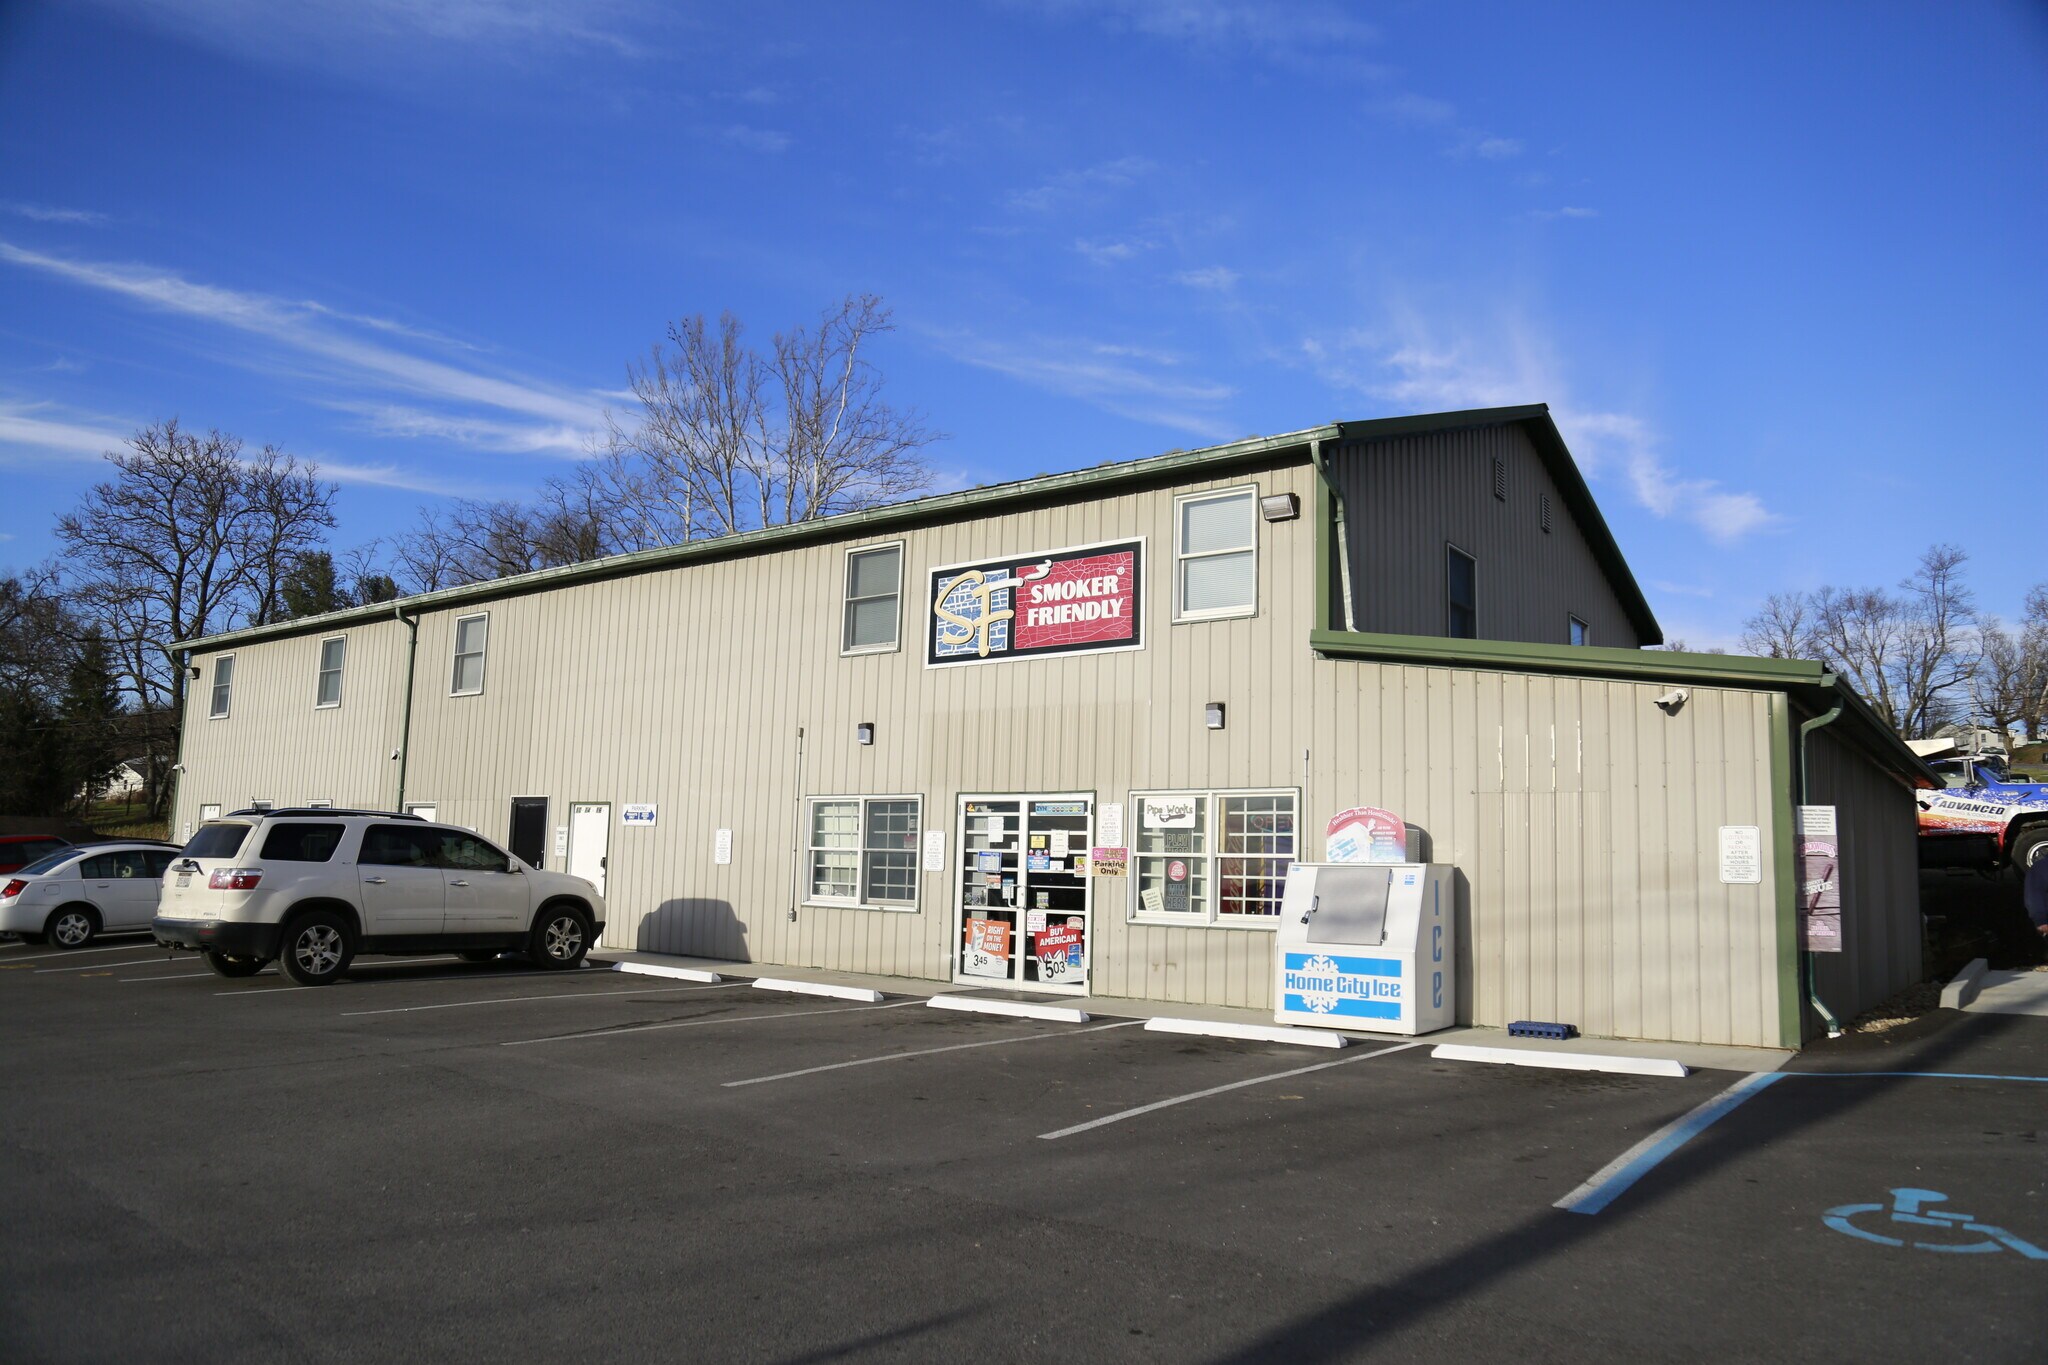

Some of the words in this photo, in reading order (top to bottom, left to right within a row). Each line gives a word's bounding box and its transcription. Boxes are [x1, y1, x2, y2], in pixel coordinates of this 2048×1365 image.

[1030, 574, 1119, 604] SMOKER
[1027, 598, 1124, 627] FRIENDLY
[1146, 804, 1163, 816] Pipe
[1166, 804, 1193, 815] Works
[1938, 800, 2006, 815] ADVANCED
[1253, 816, 1294, 829] OPEN
[1332, 812, 1354, 826] Healthier
[1166, 833, 1189, 847] PLAY
[1094, 860, 1125, 868] Parking
[1100, 867, 1119, 876] Only
[987, 925, 1005, 935] RIGHT
[1050, 926, 1065, 937] BUY
[993, 935, 1002, 943] THE
[1039, 933, 1077, 947] AMERICAN
[983, 942, 1004, 952] MONEY
[1045, 960, 1066, 979] 503
[1284, 972, 1334, 991] Home
[1336, 975, 1371, 999] City
[1373, 979, 1401, 998] Ice
